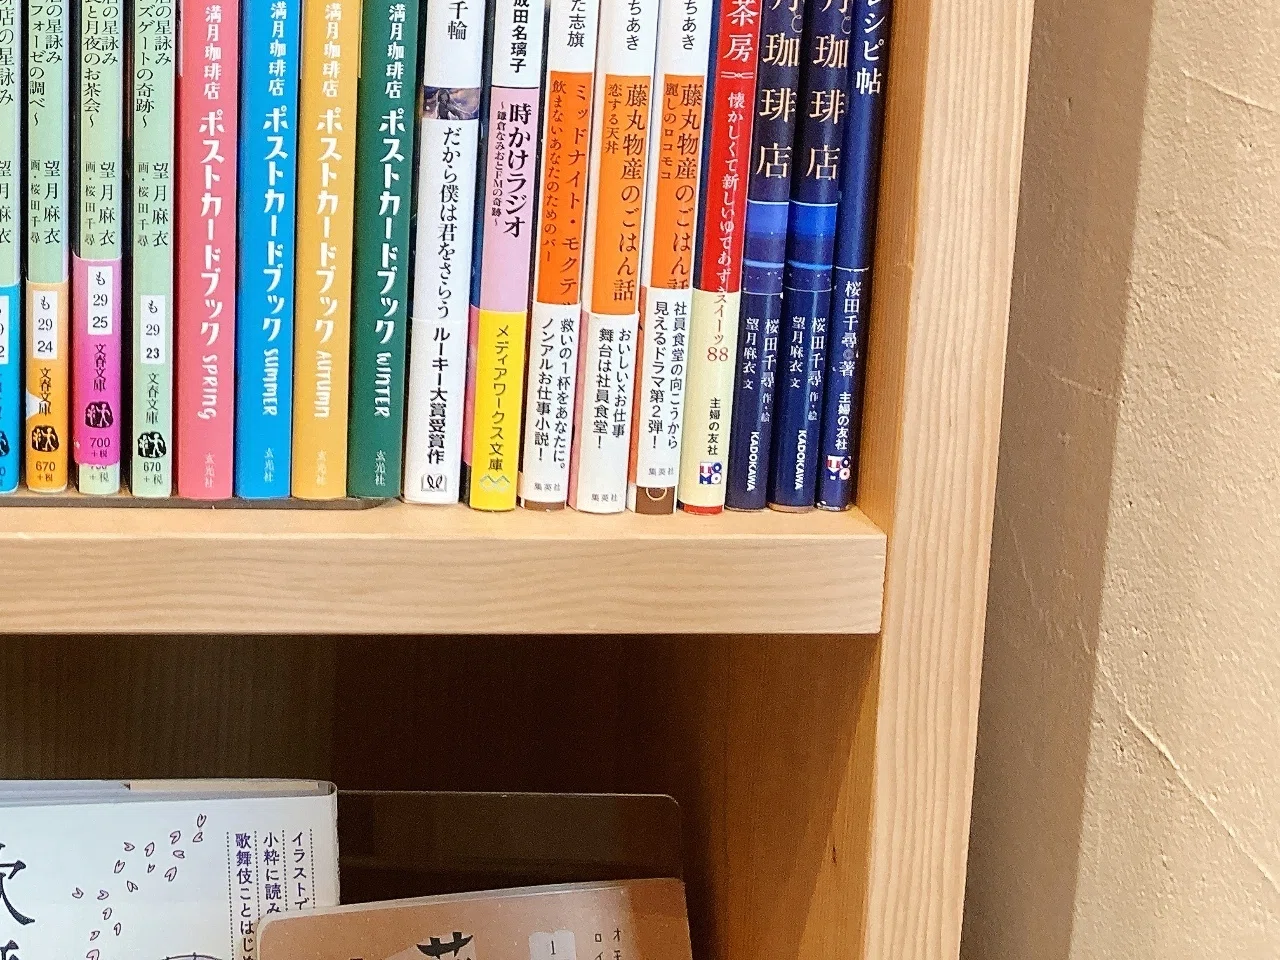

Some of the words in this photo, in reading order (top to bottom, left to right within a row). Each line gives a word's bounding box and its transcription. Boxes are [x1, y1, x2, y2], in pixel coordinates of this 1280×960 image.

[204, 4, 222, 100] 満月珈琲店
[268, 0, 287, 97] 満月珈琲店
[322, 2, 342, 98] 満月珈琲店
[385, 3, 407, 99] 満月珈琲店
[604, 83, 623, 155] 恋する天丼
[660, 82, 679, 180] 麗しのロコモコ
[43, 160, 61, 245] 望月麻衣
[98, 161, 116, 247] 望月麻衣
[151, 162, 169, 248] 望月麻衣
[503, 102, 532, 238] 時かけラジオ
[543, 80, 566, 262] 飲まないあなたのためのバー
[559, 84, 588, 305] ミッドナイト・モクテ
[613, 83, 648, 301] 藤丸物産のごはん話
[198, 108, 225, 347] ポストカードブック
[262, 105, 289, 342] ポストカードブック
[314, 106, 343, 344] ポストカードブック
[375, 107, 406, 344] ポストカードブック
[437, 126, 462, 319] だから僕は君をさらう
[40, 296, 50, 310] も
[93, 294, 108, 306] 29
[95, 271, 106, 286] も
[148, 300, 158, 313] も
[37, 318, 53, 331] 29
[37, 340, 53, 352] 24
[92, 316, 108, 328] 25
[145, 324, 160, 336] 29
[742, 316, 760, 374] 望月麻衣
[789, 315, 806, 373] 望月麻衣
[841, 280, 862, 348] 桜田千尋
[93, 343, 107, 392] 文春文庫
[146, 347, 160, 358] 23
[668, 301, 688, 450] 社員食堂の向こうから
[761, 318, 780, 388] 桜田千尋
[807, 317, 826, 387] 桜田千尋
[839, 361, 856, 377] 著
[38, 367, 52, 415] 文春文庫
[145, 373, 160, 425] 文春文庫
[426, 327, 451, 465] ルーキー大賞受賞作
[487, 324, 509, 472] メディアワークス文庫
[835, 392, 851, 450] 主婦の友社
[90, 437, 111, 448] 700
[707, 398, 721, 456] 主婦の友社
[746, 431, 760, 491] KADOKAWA
[794, 429, 807, 490] KADOKAWA
[35, 461, 56, 472] 670
[143, 461, 161, 472] 670
[591, 493, 618, 502] 集英社
[263, 831, 281, 914] 小粋に読み
[292, 831, 310, 910] イラストで
